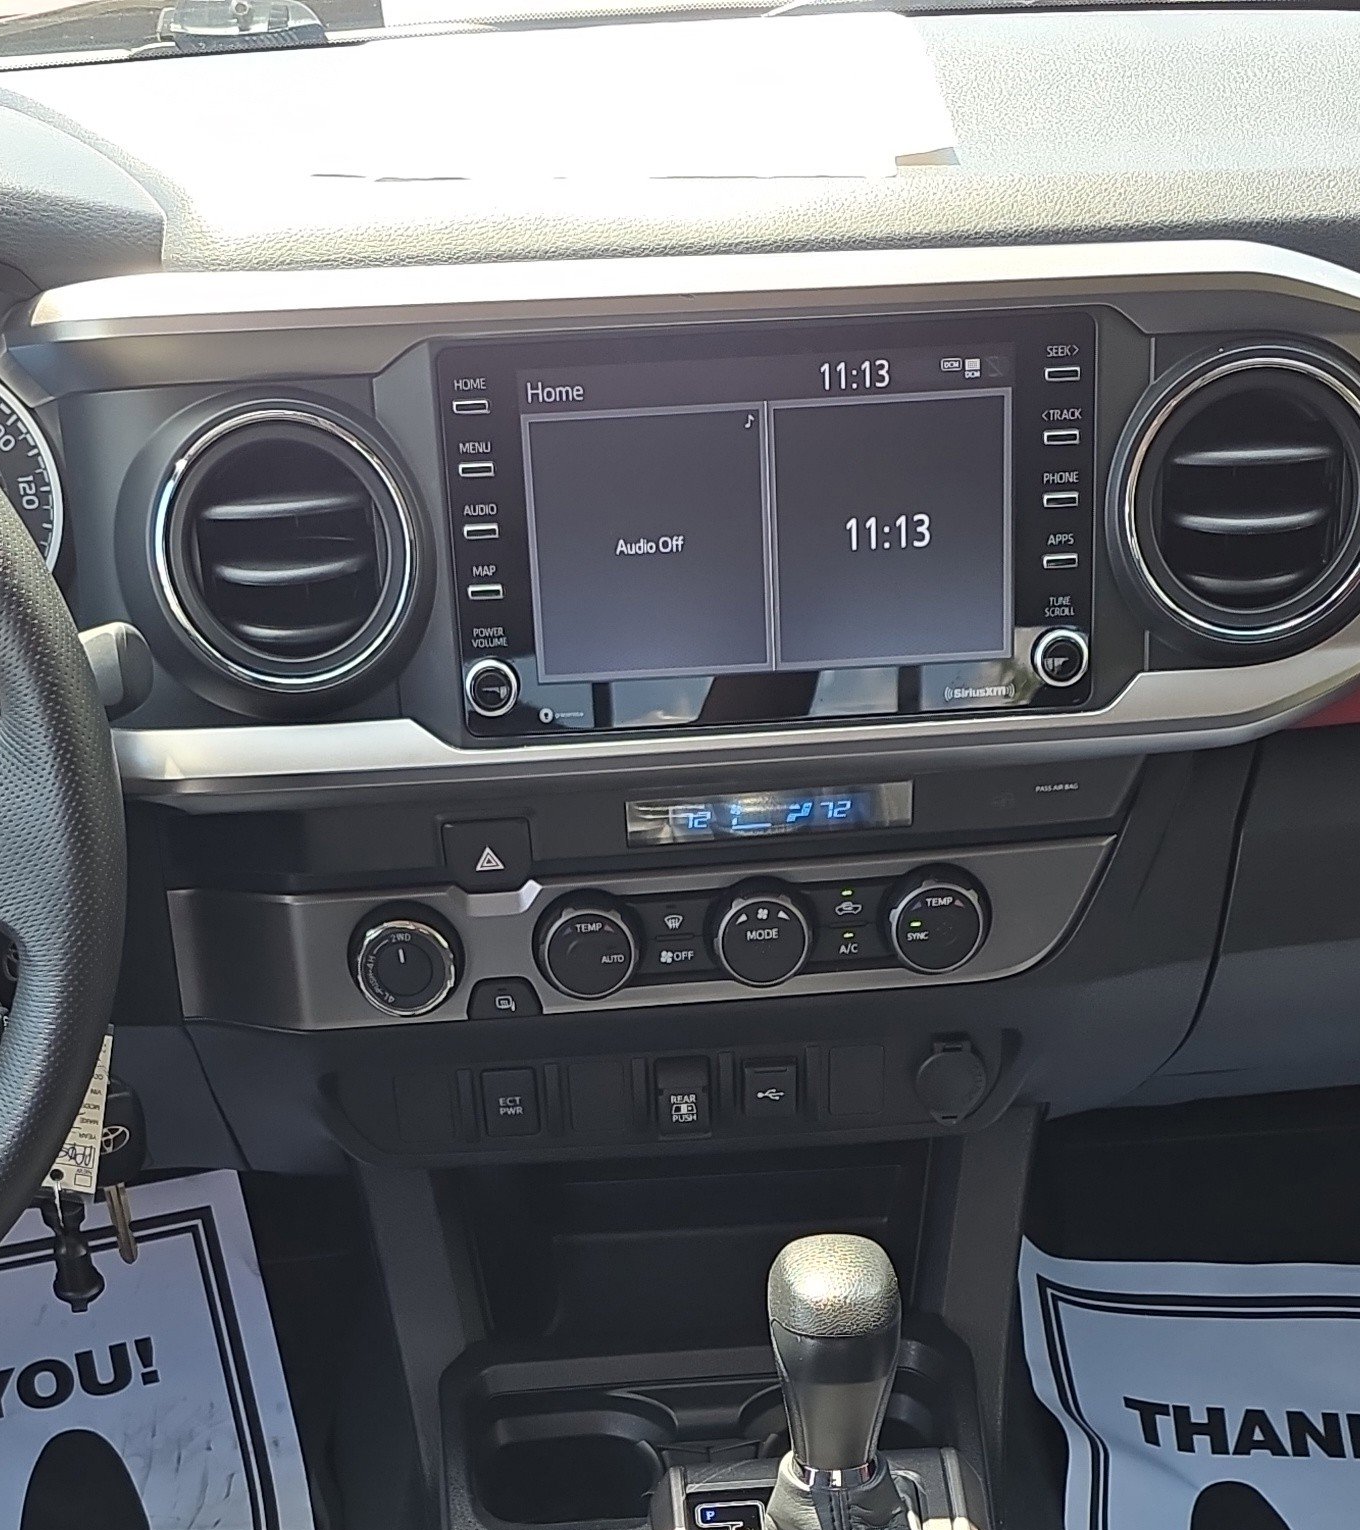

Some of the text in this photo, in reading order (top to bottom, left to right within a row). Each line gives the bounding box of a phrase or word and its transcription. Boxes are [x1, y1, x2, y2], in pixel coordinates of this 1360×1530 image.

[820, 360, 890, 390] 11:13
[454, 378, 486, 390] HOME
[527, 382, 584, 403] Home
[459, 442, 490, 454] MENU
[1043, 472, 1079, 484] PHONE
[17, 475, 39, 511] 120
[464, 504, 497, 516] AUDIO
[845, 513, 931, 551] 11:13
[616, 534, 684, 556] Audio Off
[1047, 533, 1074, 545] APPS
[472, 565, 496, 577] MAP
[1049, 596, 1071, 606] TUNE
[1044, 606, 1075, 617] SCROLL
[473, 627, 504, 637] POWER
[472, 637, 508, 648] VOLUME
[820, 799, 852, 819] 72
[687, 810, 712, 830] 72
[925, 896, 953, 907] TEMP
[575, 922, 603, 933] TEMP
[390, 932, 411, 944] 2WD
[747, 928, 779, 941] MODE
[906, 931, 929, 941] SYNC
[839, 943, 858, 955] A/C
[601, 954, 624, 964] AUTO
[673, 951, 694, 962] OFF
[499, 1097, 521, 1107] ECT
[671, 1094, 696, 1104] REAR
[499, 1106, 523, 1116] PWR
[672, 1113, 697, 1123] PUSH
[706, 1511, 715, 1520] P
